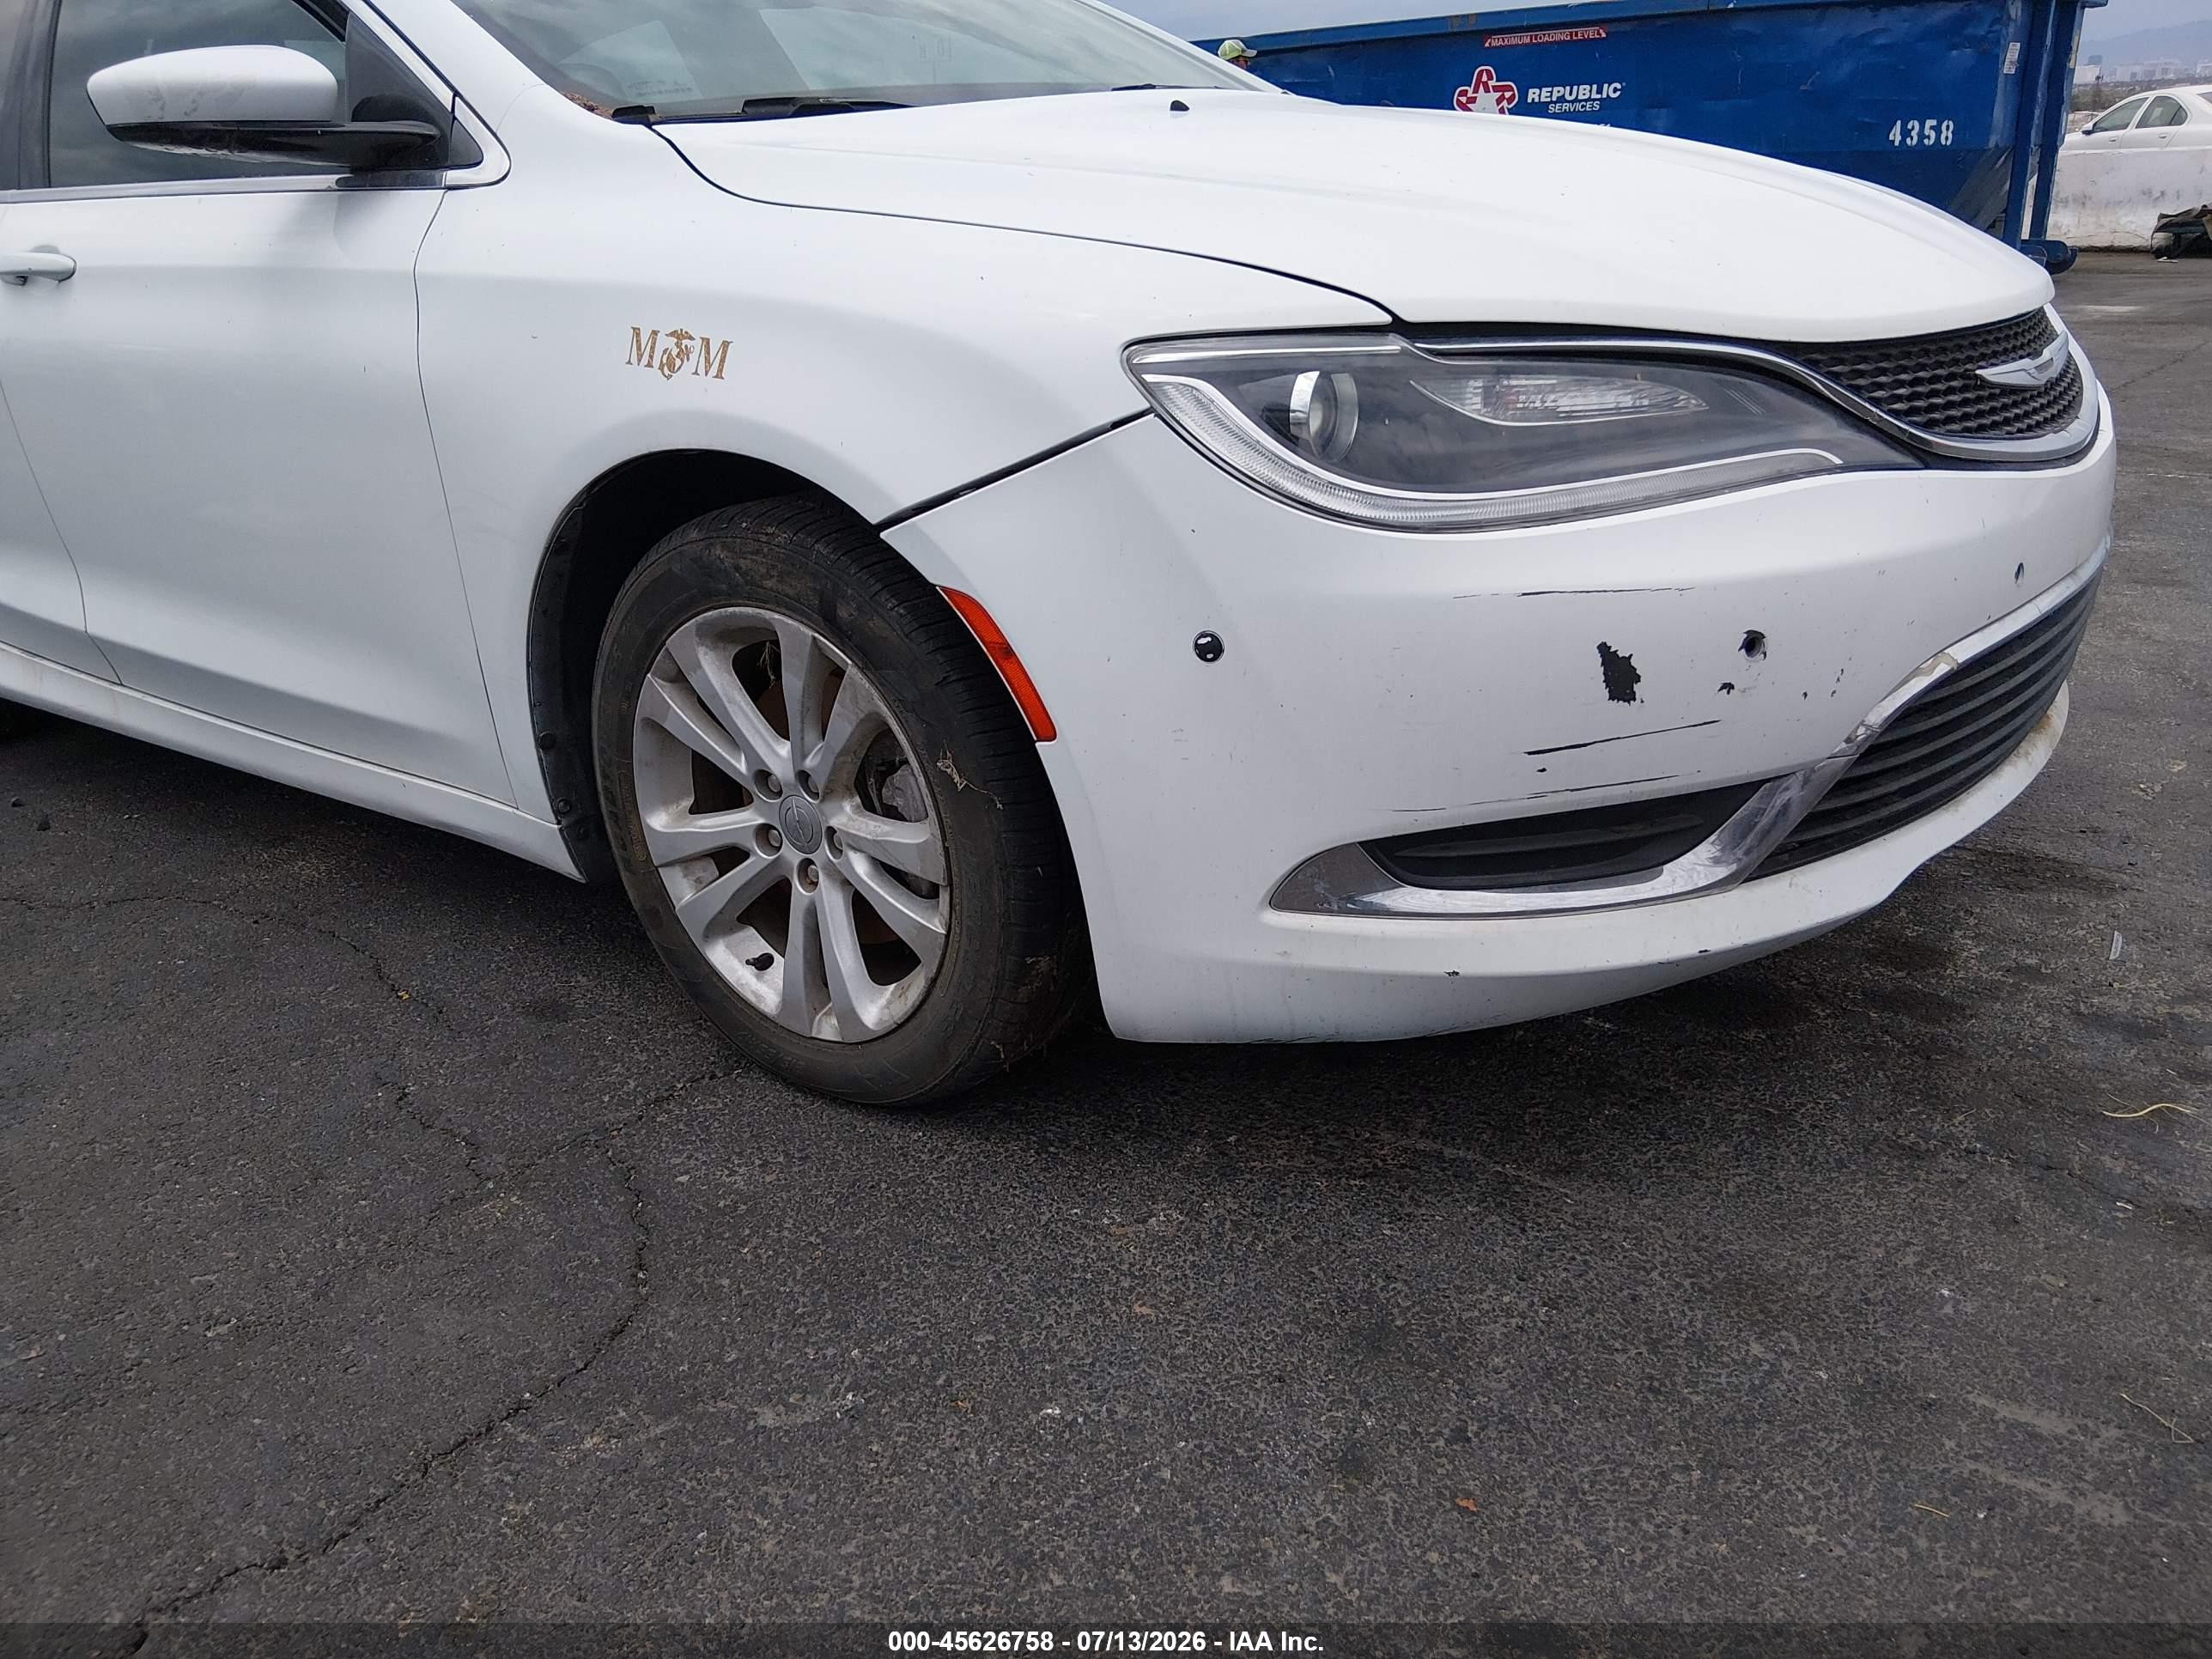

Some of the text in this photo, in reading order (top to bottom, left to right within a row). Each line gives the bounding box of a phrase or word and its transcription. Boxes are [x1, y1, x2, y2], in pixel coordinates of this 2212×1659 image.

[1491, 29, 1600, 46] MAXIMUM LOADING LEVEL
[1528, 83, 1621, 102] REPUBLIC
[1547, 101, 1601, 113] SERVICES
[1888, 118, 1954, 147] 4358
